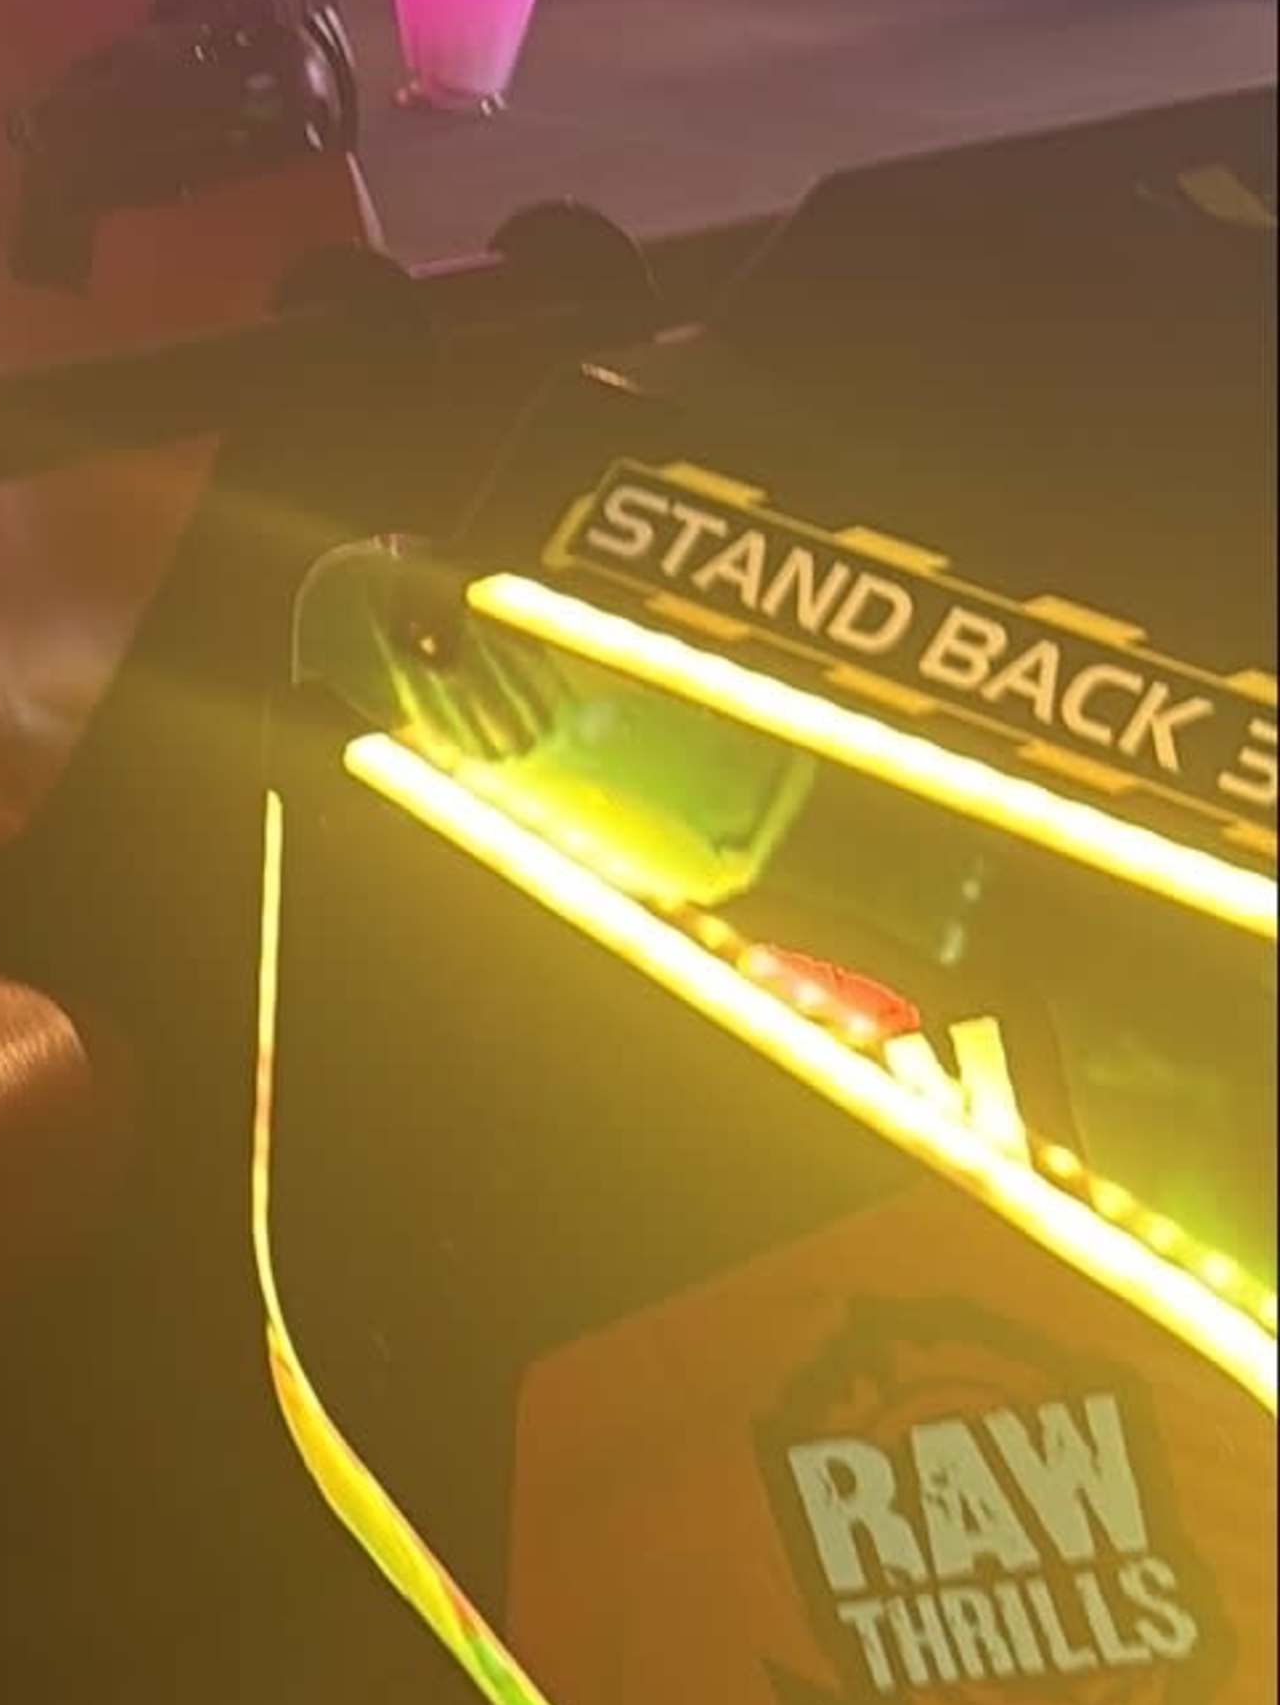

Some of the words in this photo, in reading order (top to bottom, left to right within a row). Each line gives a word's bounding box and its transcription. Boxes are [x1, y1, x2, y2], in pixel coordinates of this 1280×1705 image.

[587, 483, 914, 656] STAND
[918, 606, 1214, 774] BACK
[787, 1394, 1151, 1592] RAW
[839, 1557, 1199, 1694] THRILLS
